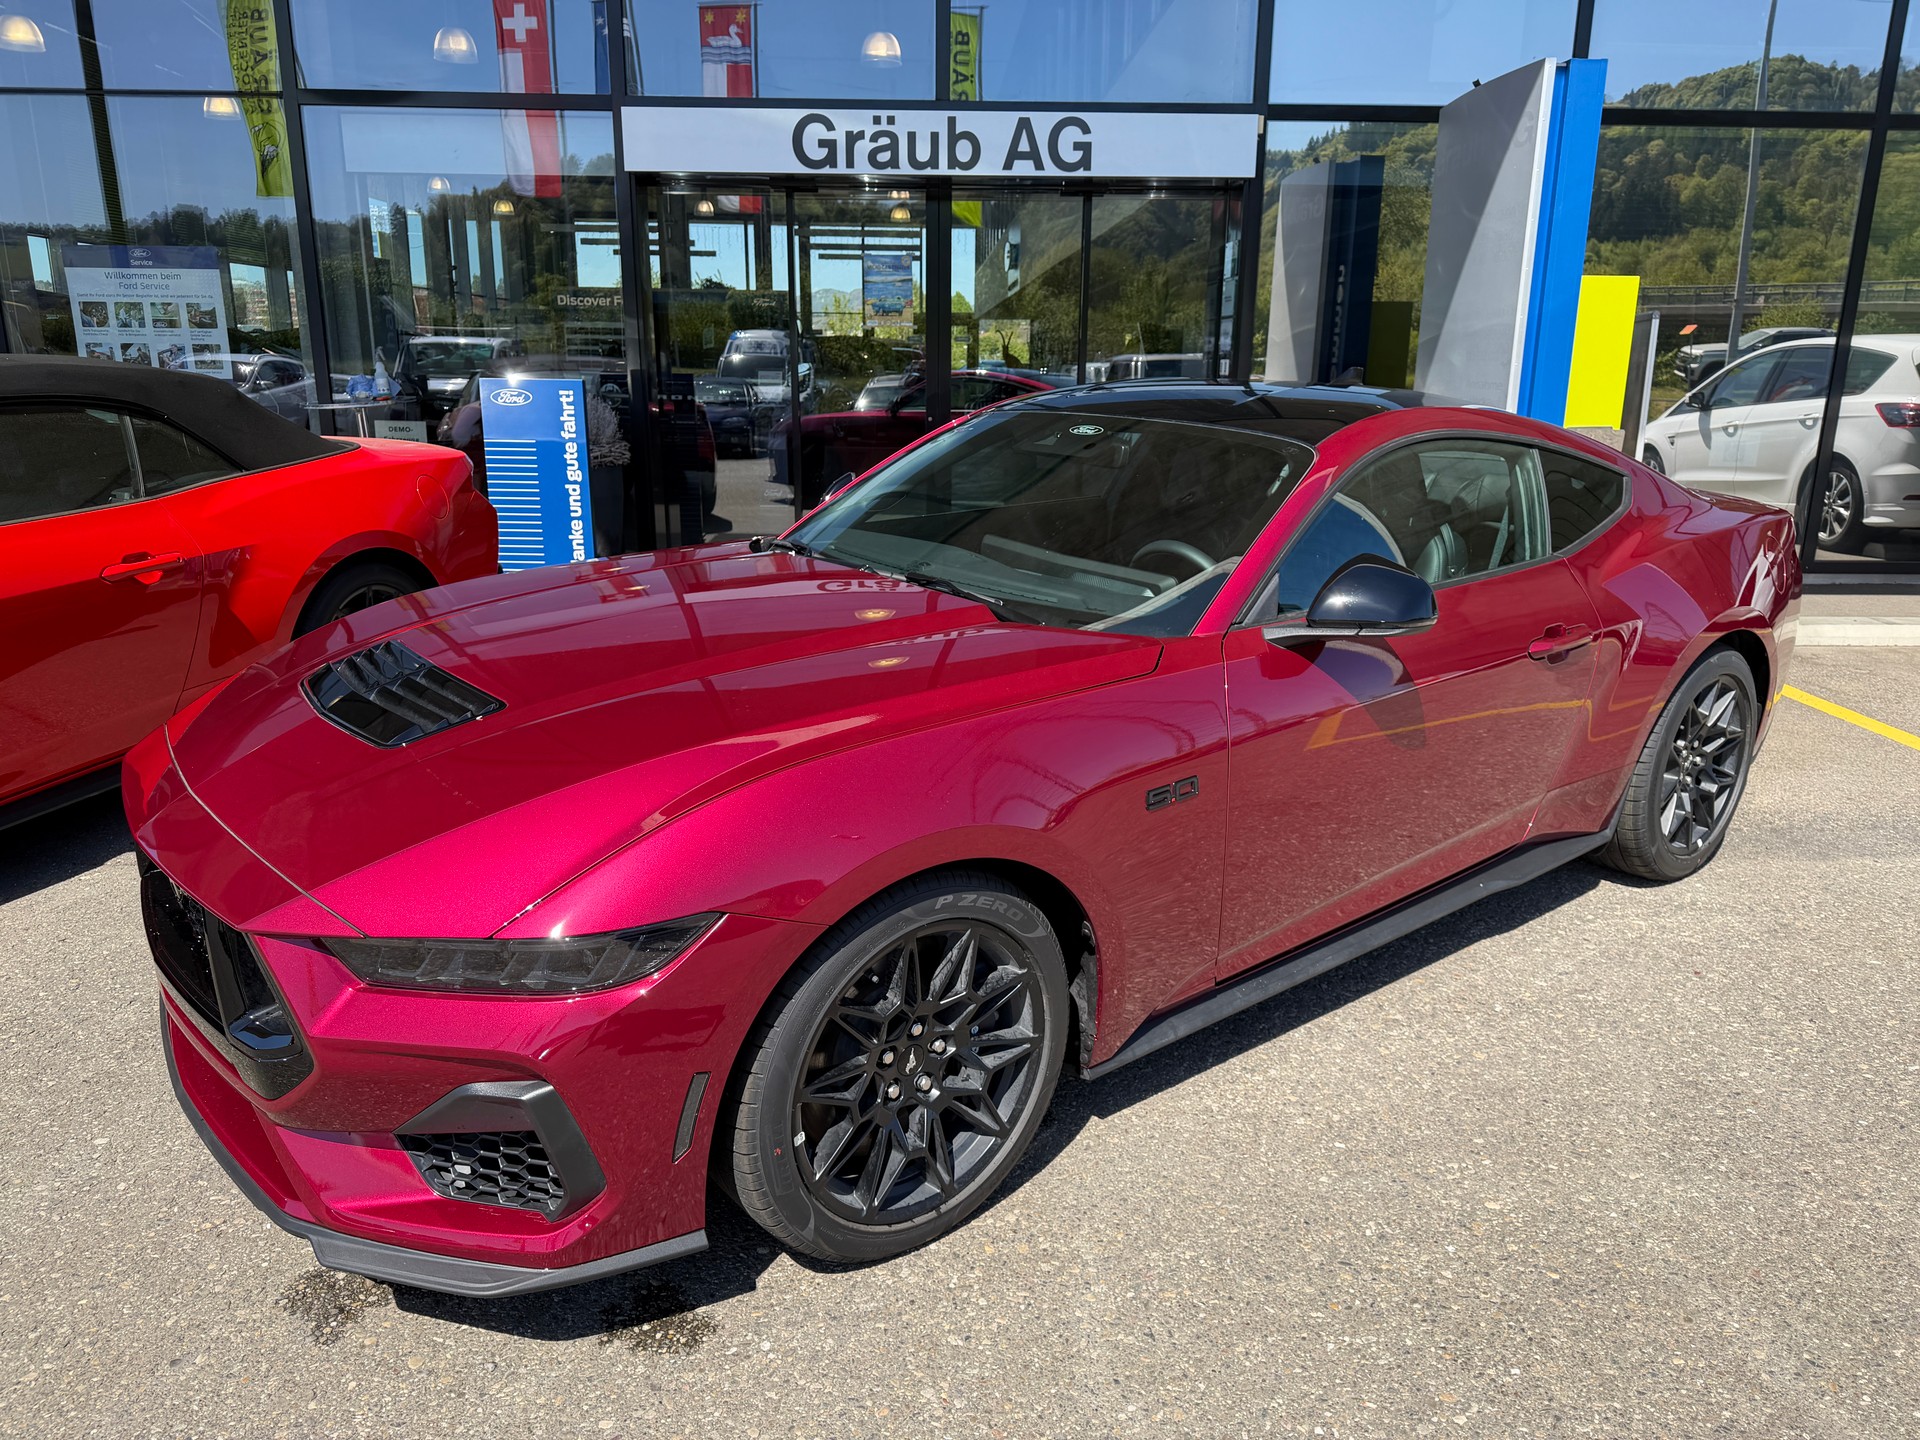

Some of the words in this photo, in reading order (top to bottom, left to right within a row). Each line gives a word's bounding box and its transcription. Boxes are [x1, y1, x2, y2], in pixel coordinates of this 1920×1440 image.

[792, 113, 981, 171] Gräub
[1002, 116, 1092, 172] AG
[104, 272, 158, 280] Willkommen
[161, 272, 181, 280] beim
[118, 282, 138, 290] Ford
[140, 282, 170, 290] Service
[557, 294, 611, 306] Discover
[497, 390, 526, 404] Ford
[559, 389, 577, 440] fahrt!
[562, 442, 582, 482] gute
[565, 484, 582, 517] und
[569, 520, 585, 563] anke
[1146, 775, 1199, 812] 5.0
[934, 894, 953, 909] P
[958, 894, 1024, 921] ZERO
